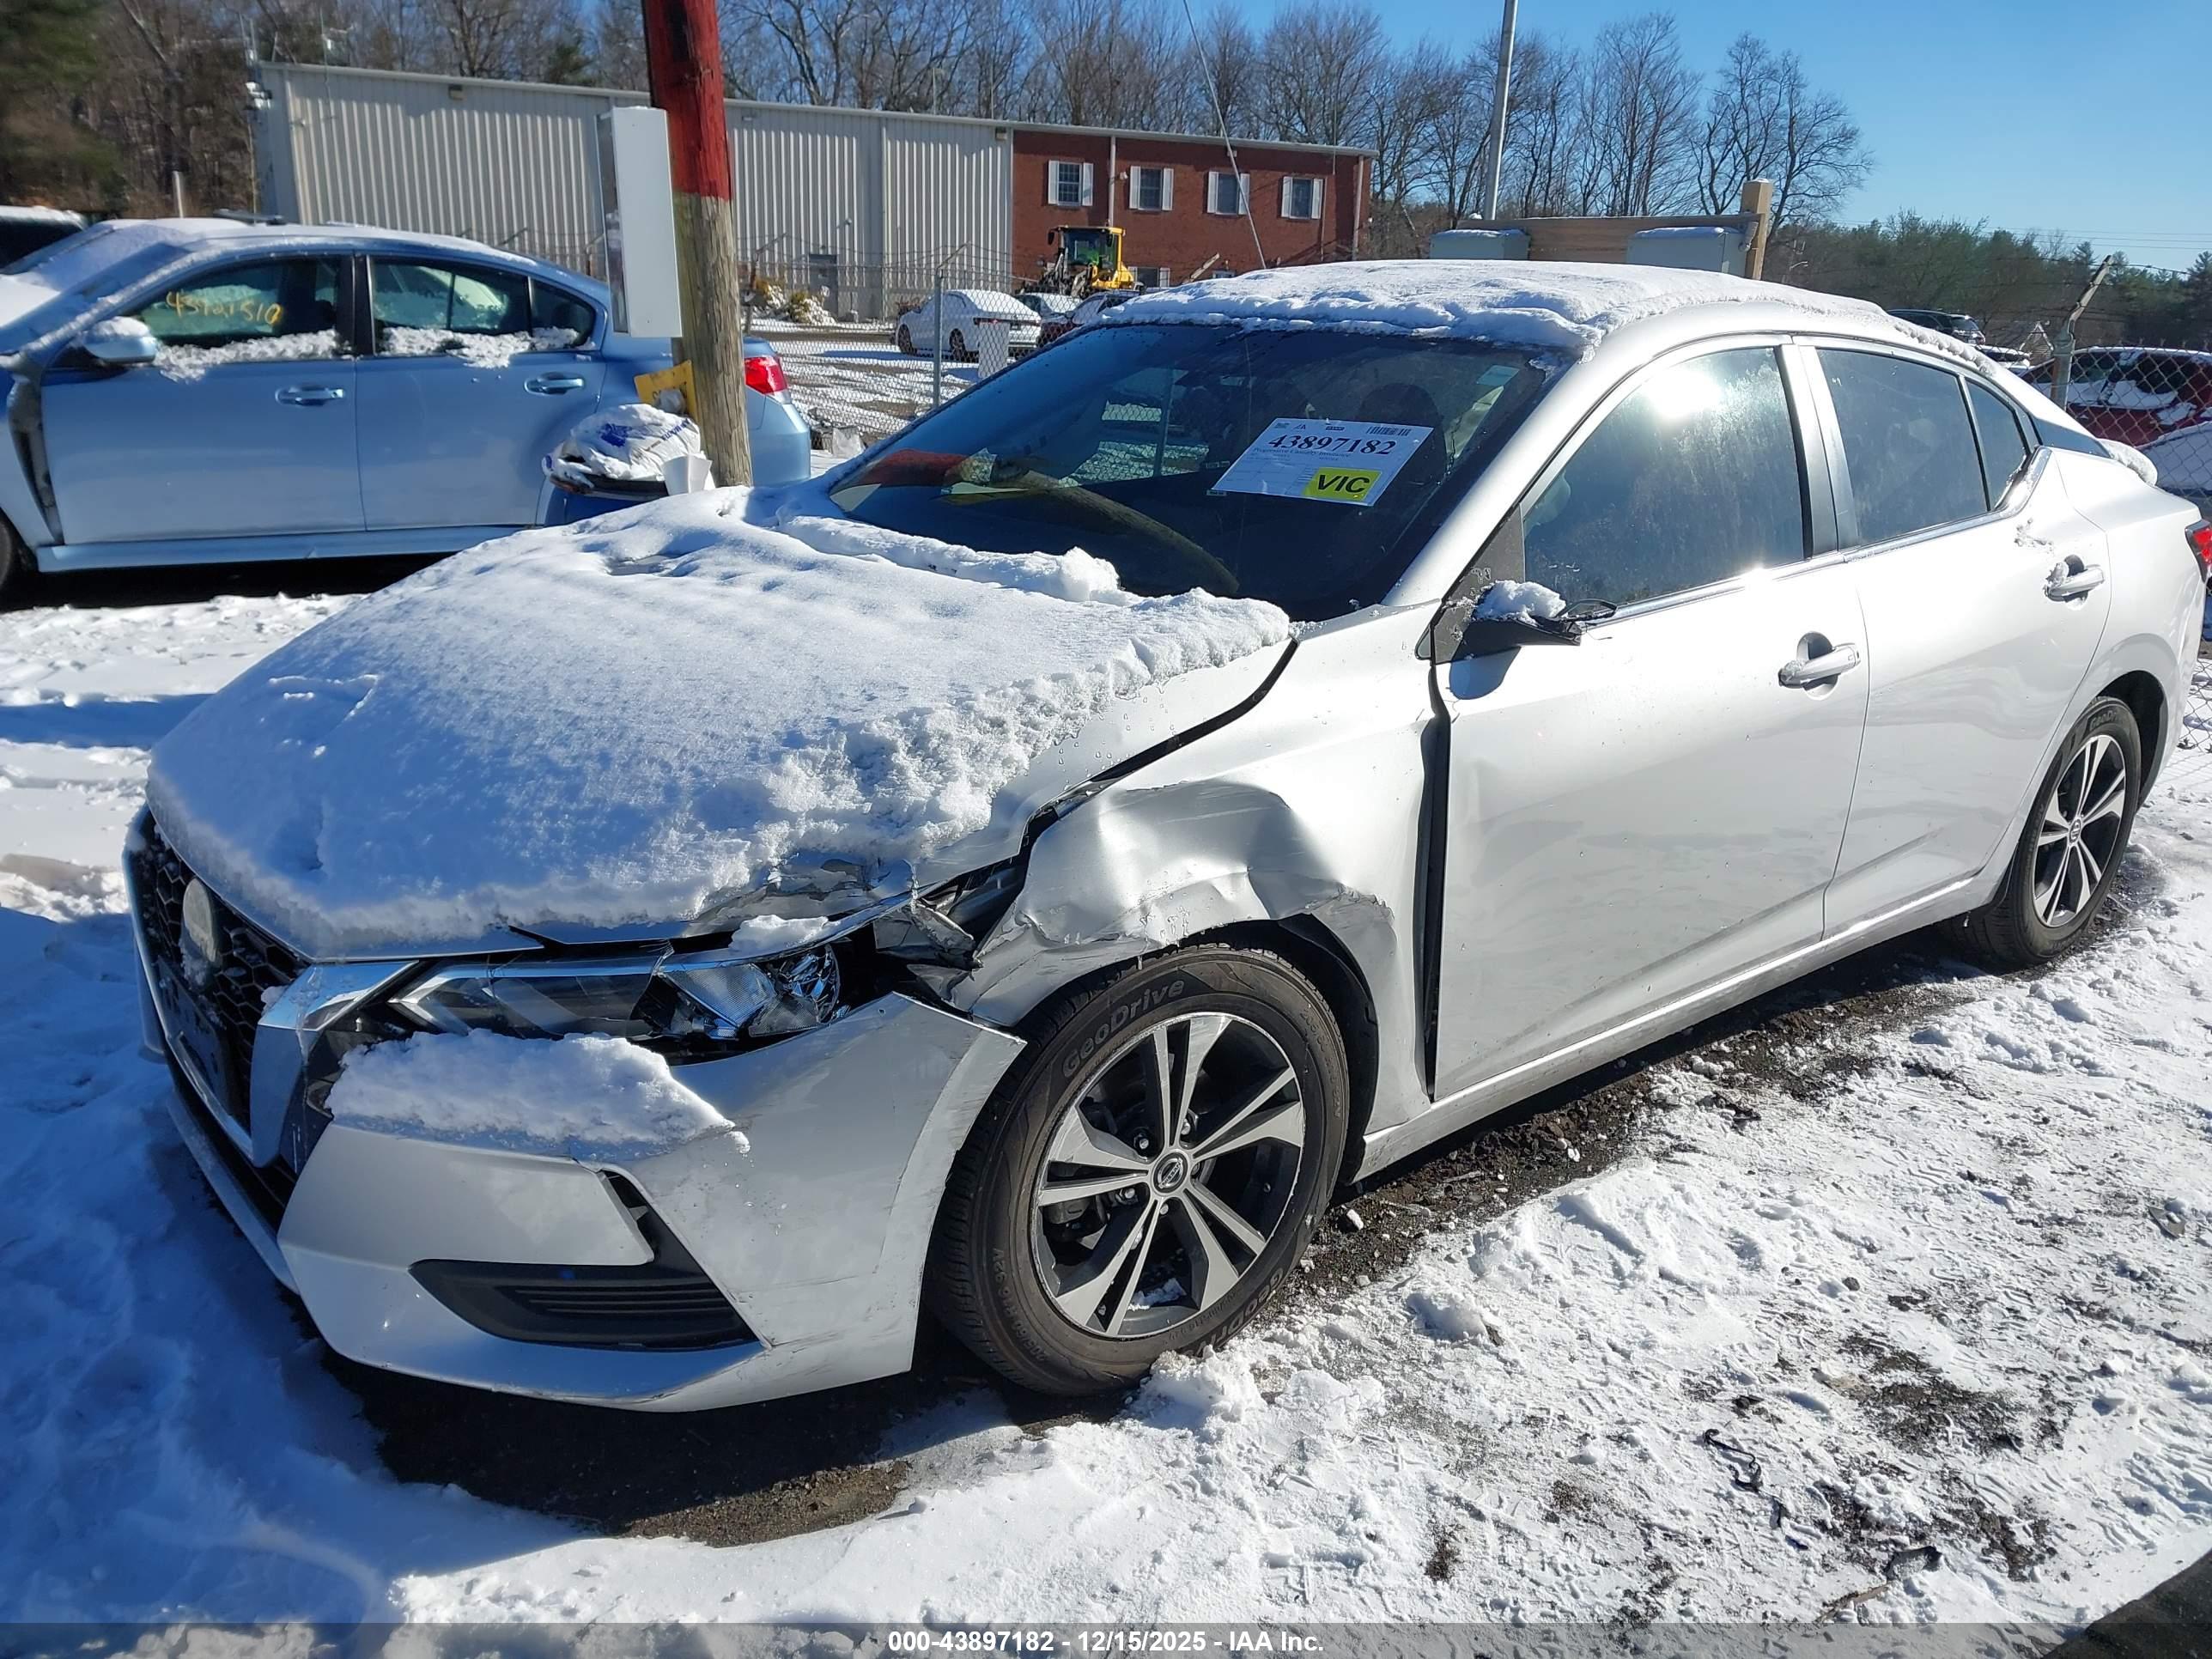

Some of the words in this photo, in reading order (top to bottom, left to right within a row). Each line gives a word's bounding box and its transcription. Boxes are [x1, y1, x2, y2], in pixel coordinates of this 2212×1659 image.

[1268, 434, 1396, 454] 43897182
[1318, 474, 1370, 493] VIC
[1063, 980, 1184, 1078] GeoDrive
